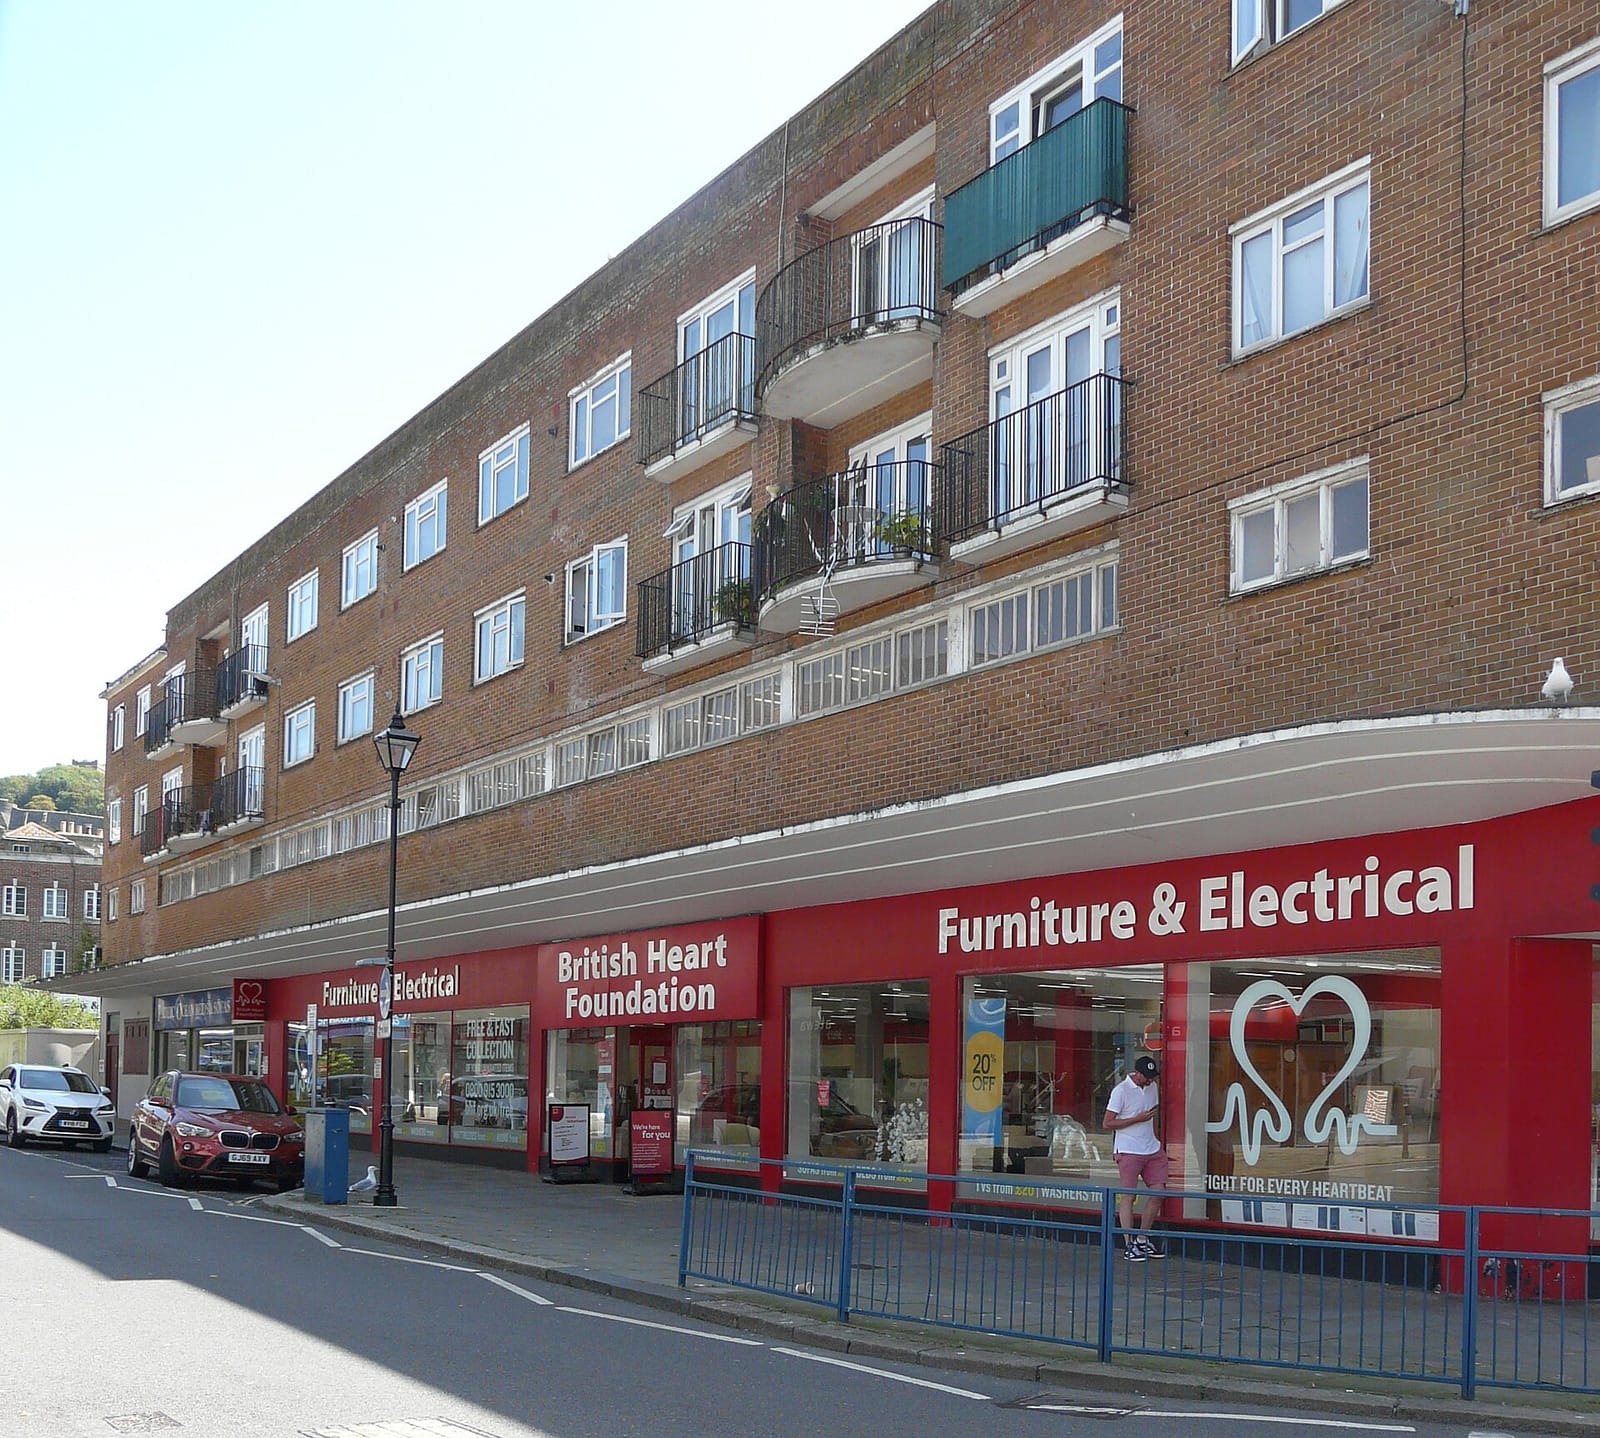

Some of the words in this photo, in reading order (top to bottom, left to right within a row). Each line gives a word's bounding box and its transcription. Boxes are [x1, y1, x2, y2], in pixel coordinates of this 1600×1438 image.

[938, 896, 1136, 955] Furniture
[1148, 881, 1187, 936] &
[1199, 843, 1476, 933] Electrical
[558, 942, 637, 983] British
[647, 934, 728, 975] Heart
[322, 978, 379, 1007] Furniture
[393, 965, 460, 1001] Electrical
[565, 976, 715, 1019] Foundation
[466, 1019, 486, 1038] FREE
[486, 1019, 494, 1037] &
[494, 1016, 515, 1037] FAST
[466, 1040, 514, 1060] COLLECTION
[496, 1082, 515, 1099] 3000
[972, 1075, 996, 1091] OFF
[642, 1131, 655, 1139] for
[655, 1132, 671, 1141] you
[1203, 1174, 1238, 1192] FIGHT
[1240, 1176, 1265, 1193] FOR
[1267, 1177, 1310, 1196] EVERY
[1312, 1180, 1394, 1202] HEARTBEAT
